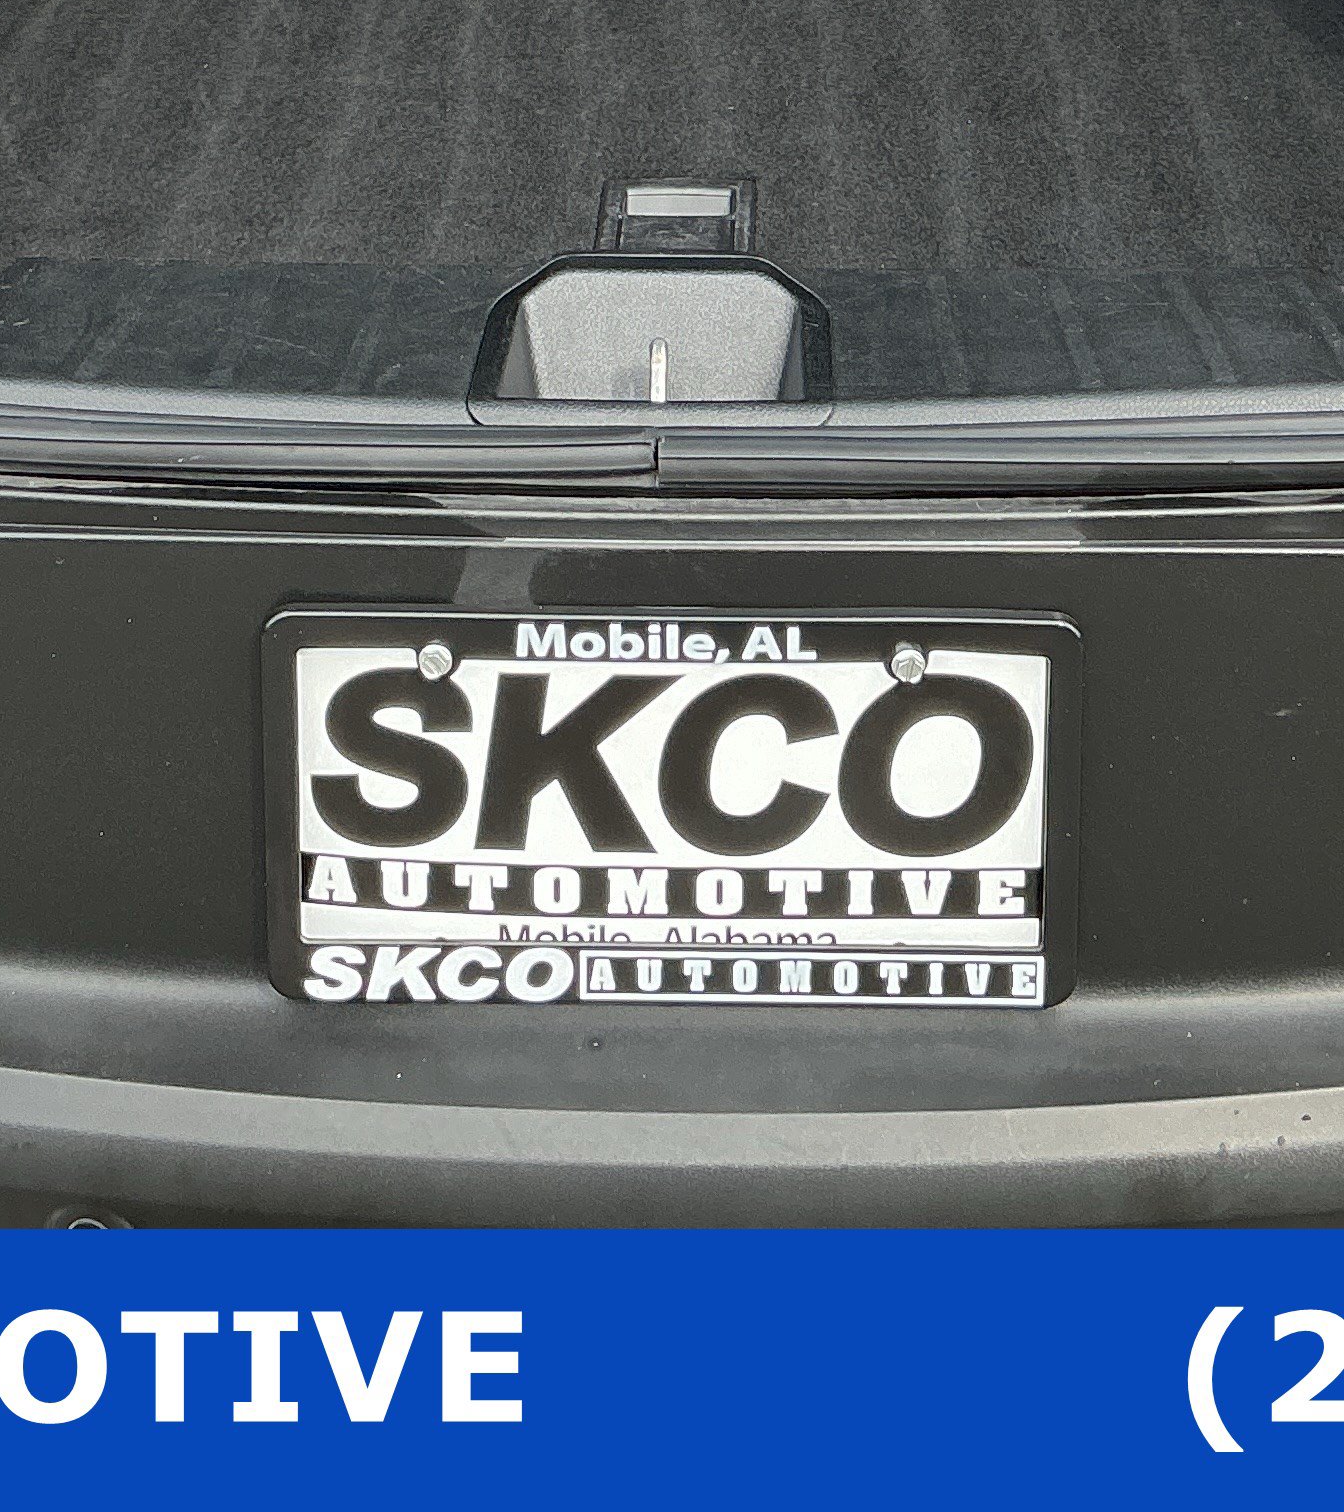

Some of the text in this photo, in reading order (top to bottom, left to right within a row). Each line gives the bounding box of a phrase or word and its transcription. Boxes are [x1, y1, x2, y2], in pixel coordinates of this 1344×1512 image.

[516, 621, 818, 664] Mobile, AL
[311, 666, 1034, 857] SKCO
[308, 855, 1026, 917] AUTOMOTIVE
[303, 945, 1037, 1003] SKCO AUTOMOTIVE
